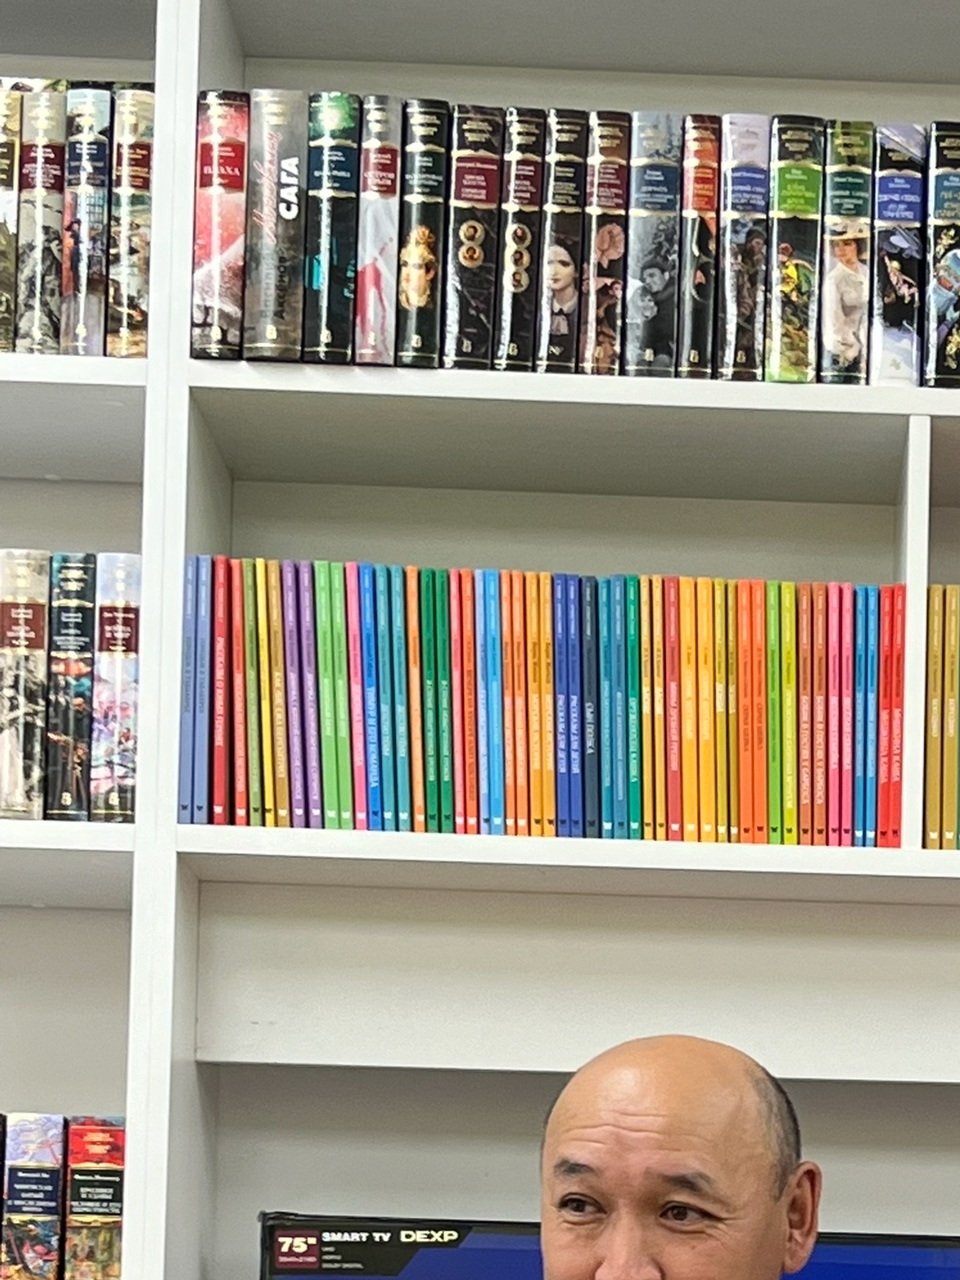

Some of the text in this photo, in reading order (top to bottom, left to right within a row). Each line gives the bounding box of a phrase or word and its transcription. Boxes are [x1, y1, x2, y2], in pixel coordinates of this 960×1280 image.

[279, 157, 299, 220] САГА
[322, 1230, 458, 1242] SMART TV DEXP
